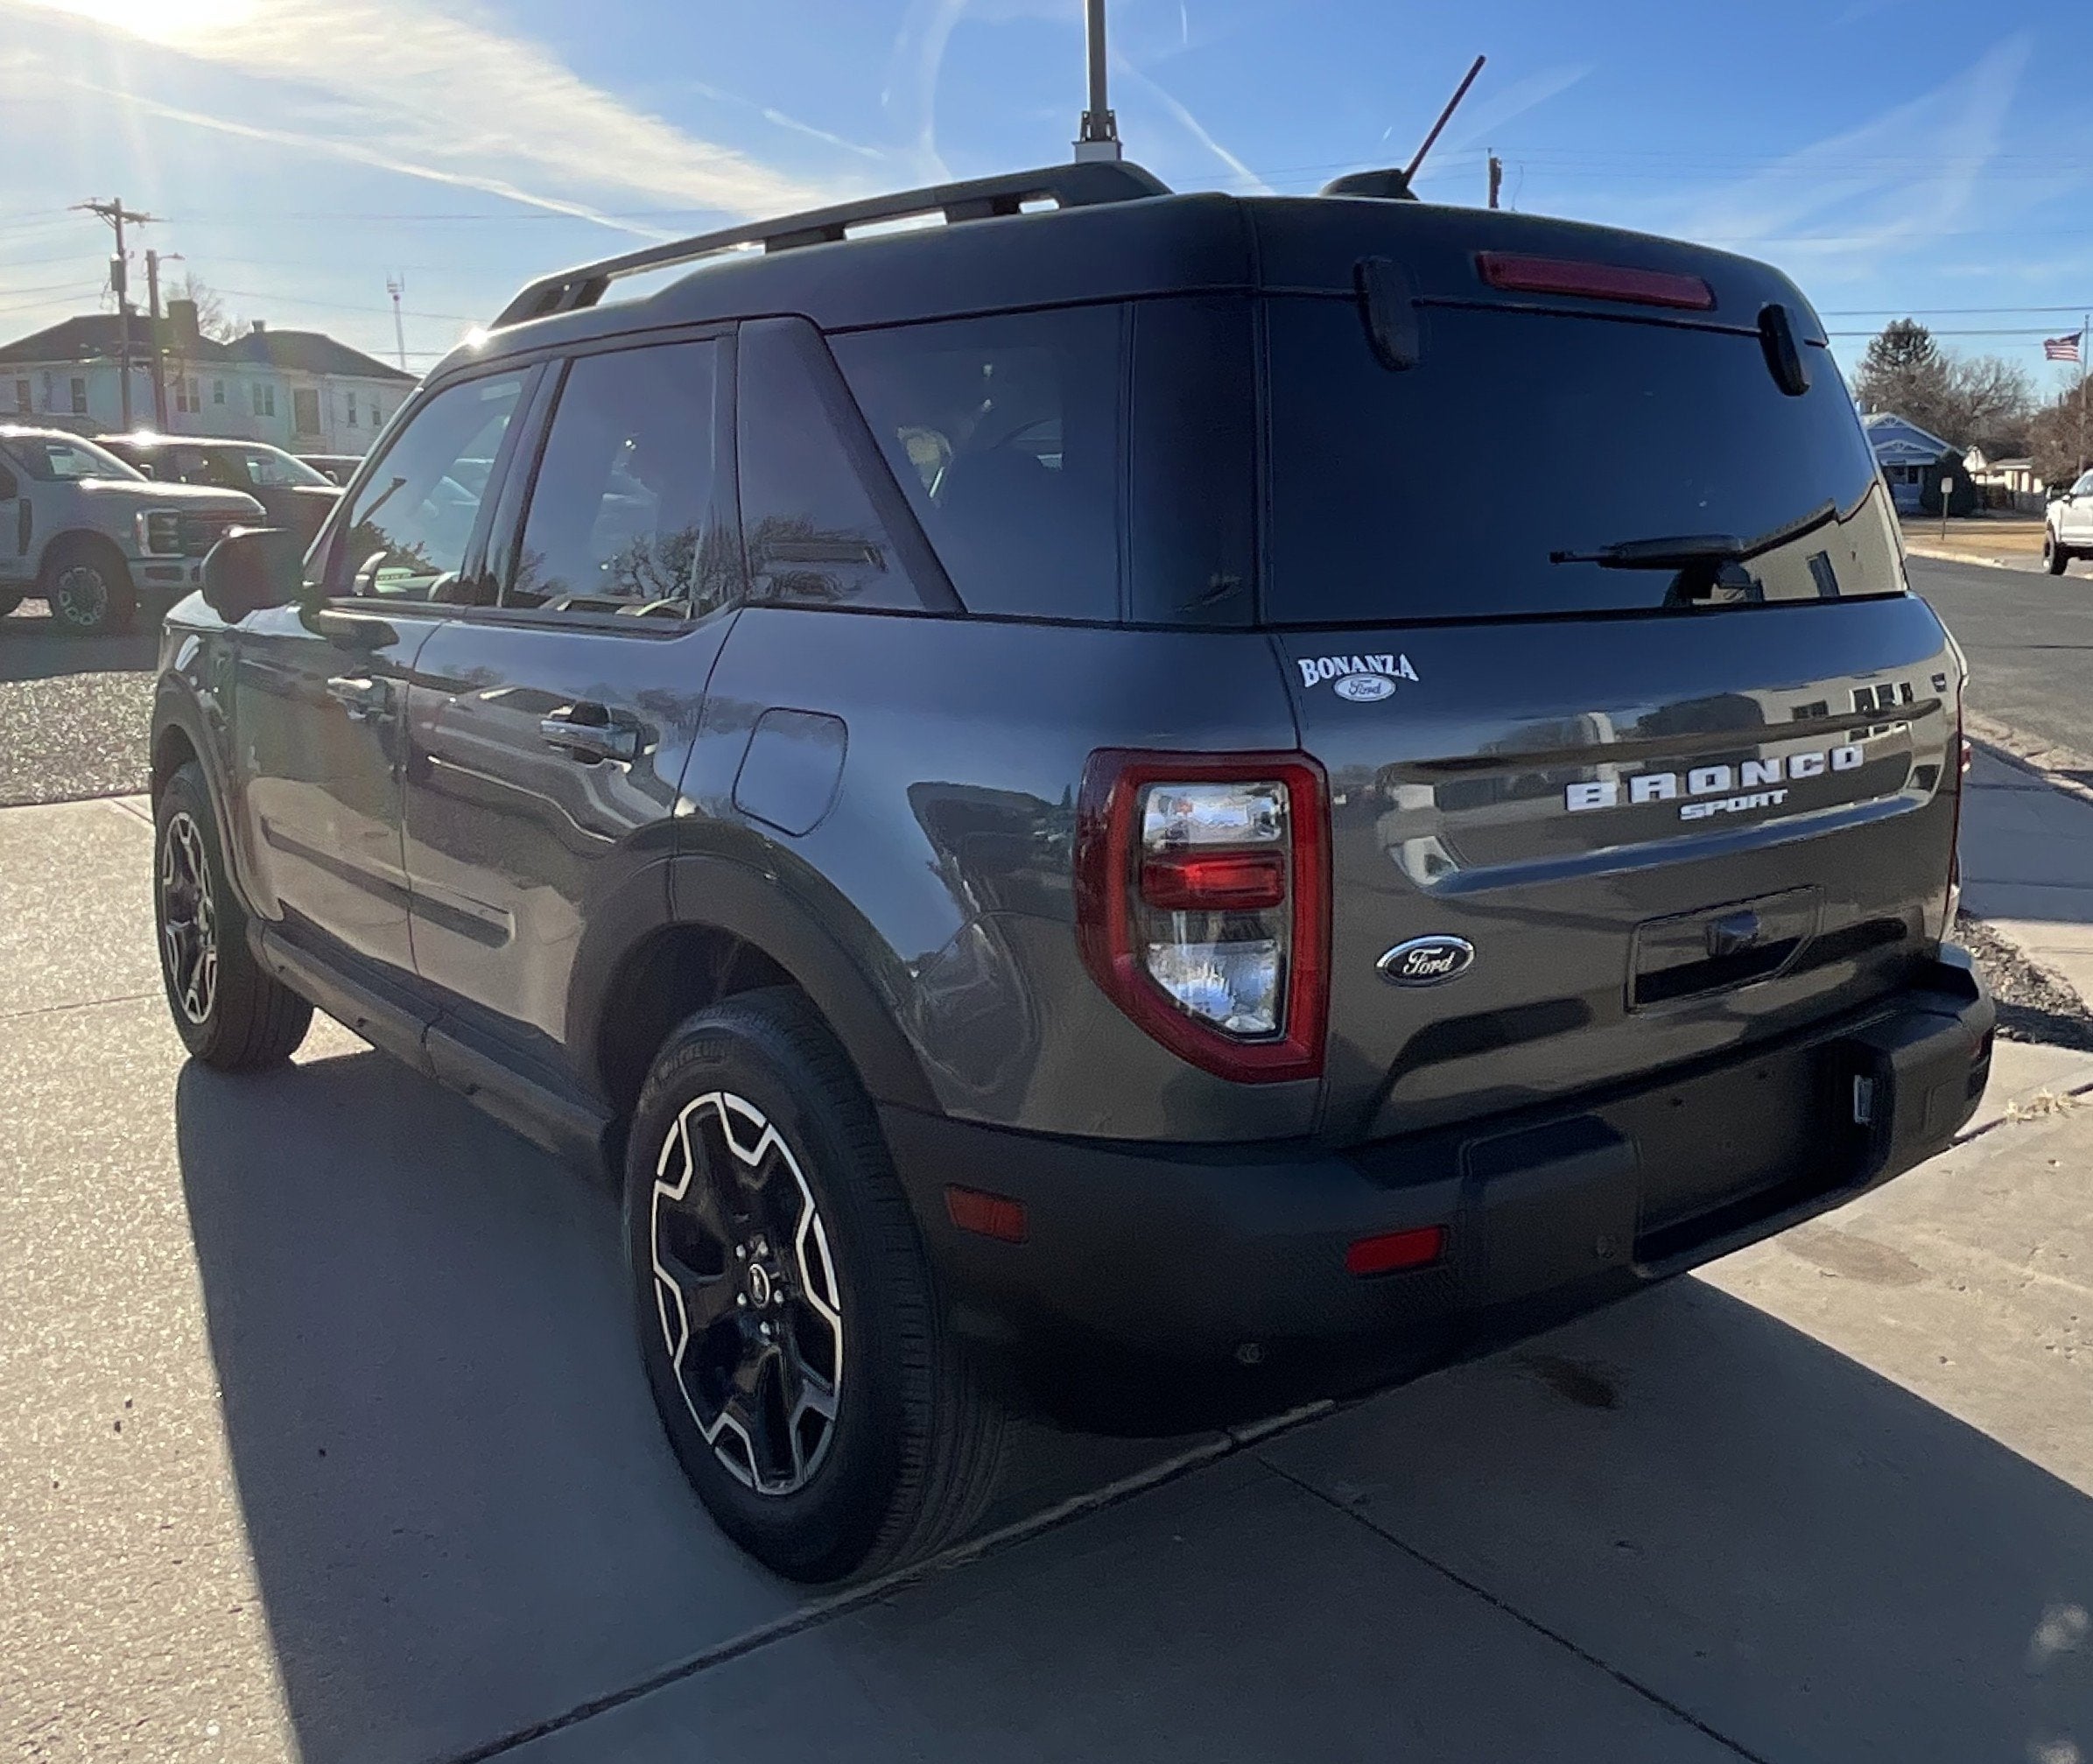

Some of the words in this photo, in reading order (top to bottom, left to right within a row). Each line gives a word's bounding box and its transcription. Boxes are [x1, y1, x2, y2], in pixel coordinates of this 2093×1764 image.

[1298, 654, 1419, 687] BONANZA
[1348, 679, 1381, 695] Ford
[1566, 745, 1864, 812] BRONCO
[1679, 789, 1788, 820] SPORT
[1402, 947, 1456, 975] Ford
